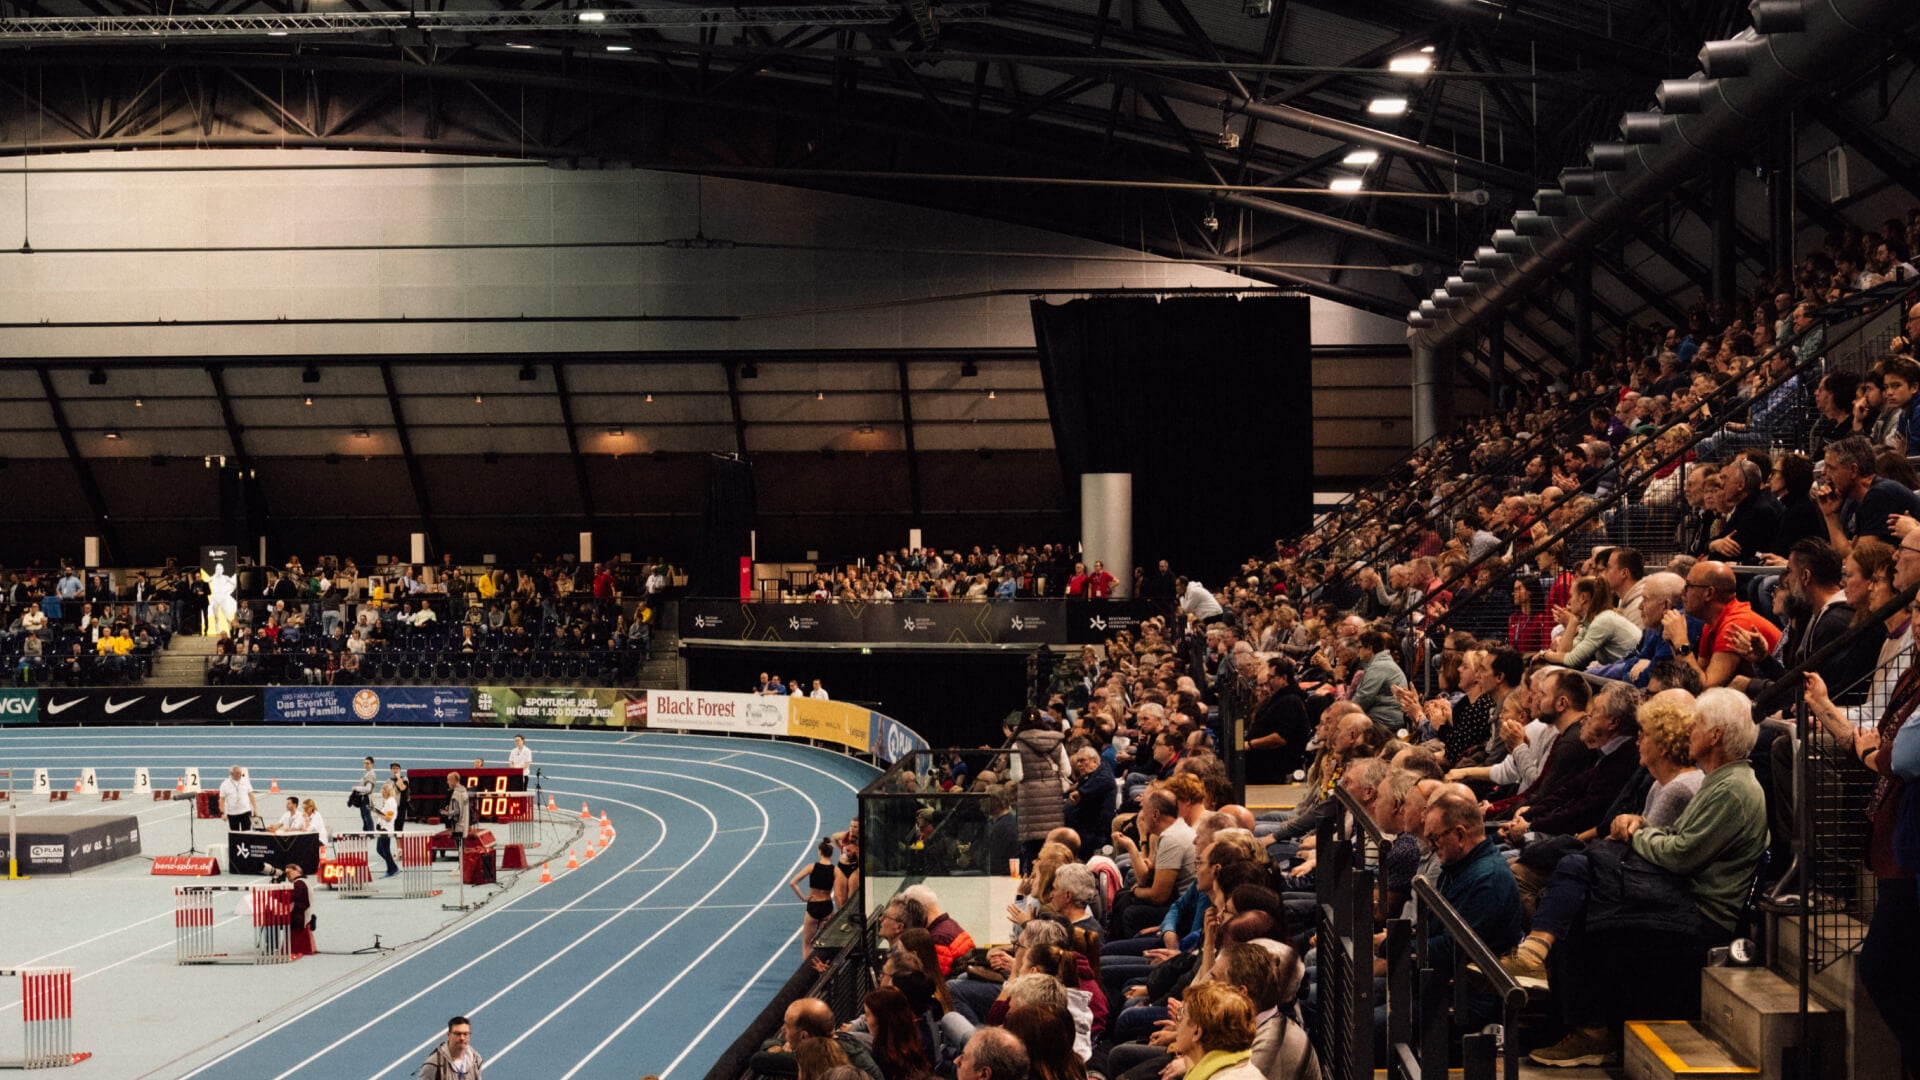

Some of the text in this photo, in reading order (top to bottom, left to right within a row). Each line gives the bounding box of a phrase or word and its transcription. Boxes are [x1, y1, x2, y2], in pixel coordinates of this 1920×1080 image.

[276, 697, 338, 710] Das Event für
[526, 697, 598, 708] SPORTLICHE JOBS
[656, 696, 694, 716] Black
[697, 697, 736, 718] Forest
[284, 705, 346, 718] eure Familie
[506, 706, 516, 716] IN
[517, 705, 540, 717] ÜBER
[541, 707, 563, 717] 1.500
[564, 707, 616, 718] DISZIPLINEN.
[40, 774, 47, 787] 5
[87, 774, 95, 787] 4
[141, 774, 148, 787] 3
[191, 773, 198, 786] 2
[155, 863, 211, 872] benz-sport.de
